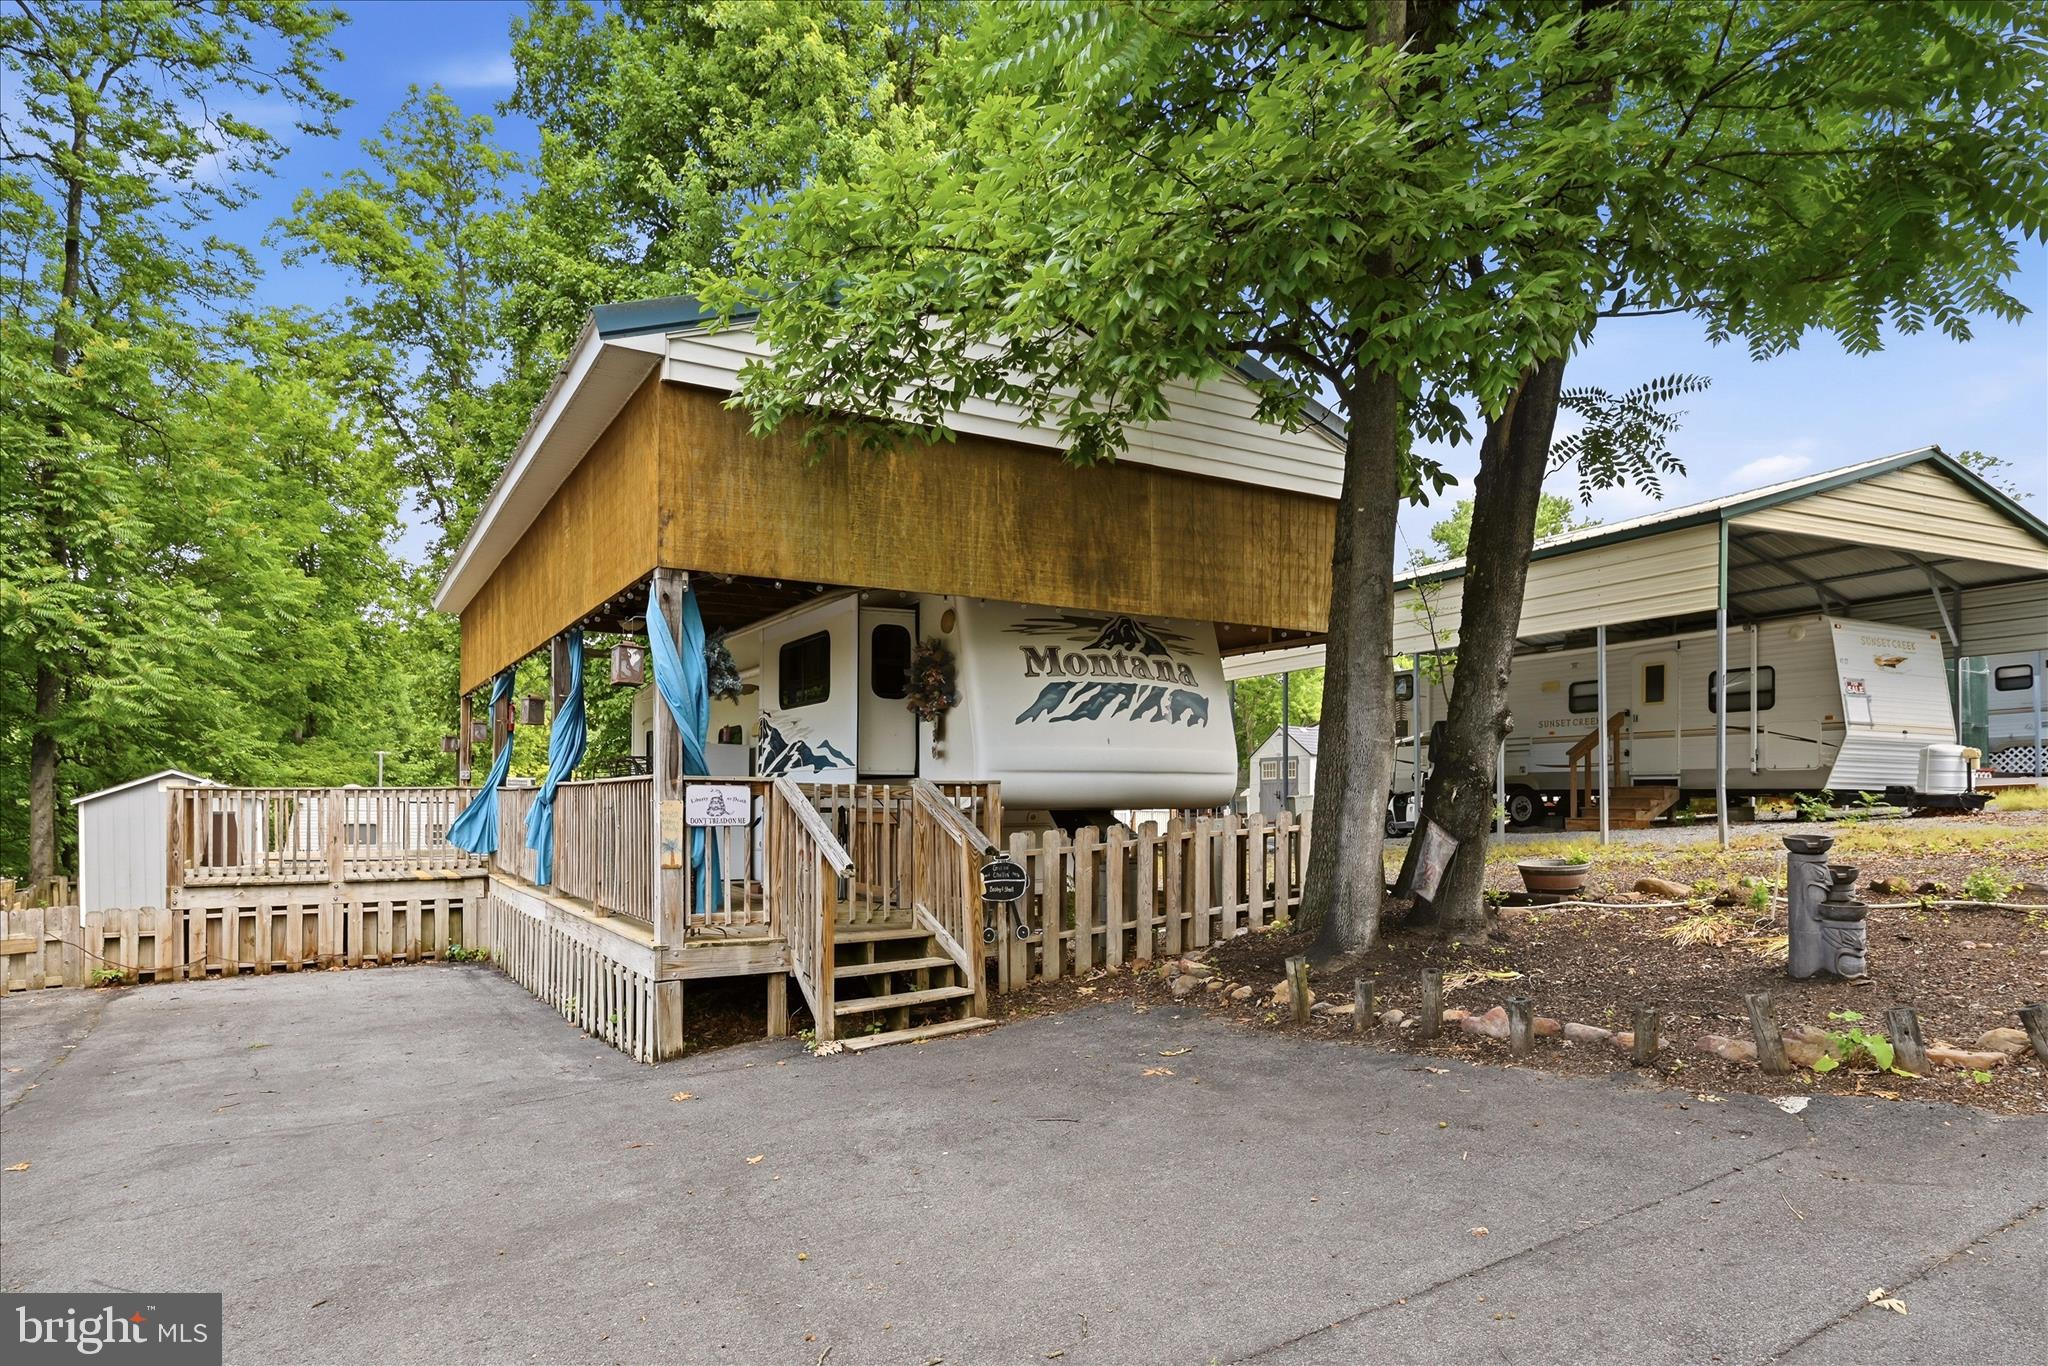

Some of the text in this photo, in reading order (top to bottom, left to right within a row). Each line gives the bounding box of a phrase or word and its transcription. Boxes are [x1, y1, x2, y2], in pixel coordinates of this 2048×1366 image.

[1860, 636, 1917, 651] SUNSET CREEK
[1019, 645, 1199, 687] Montana
[1848, 686, 1864, 694] SALE
[1538, 719, 1571, 729] SUNSET
